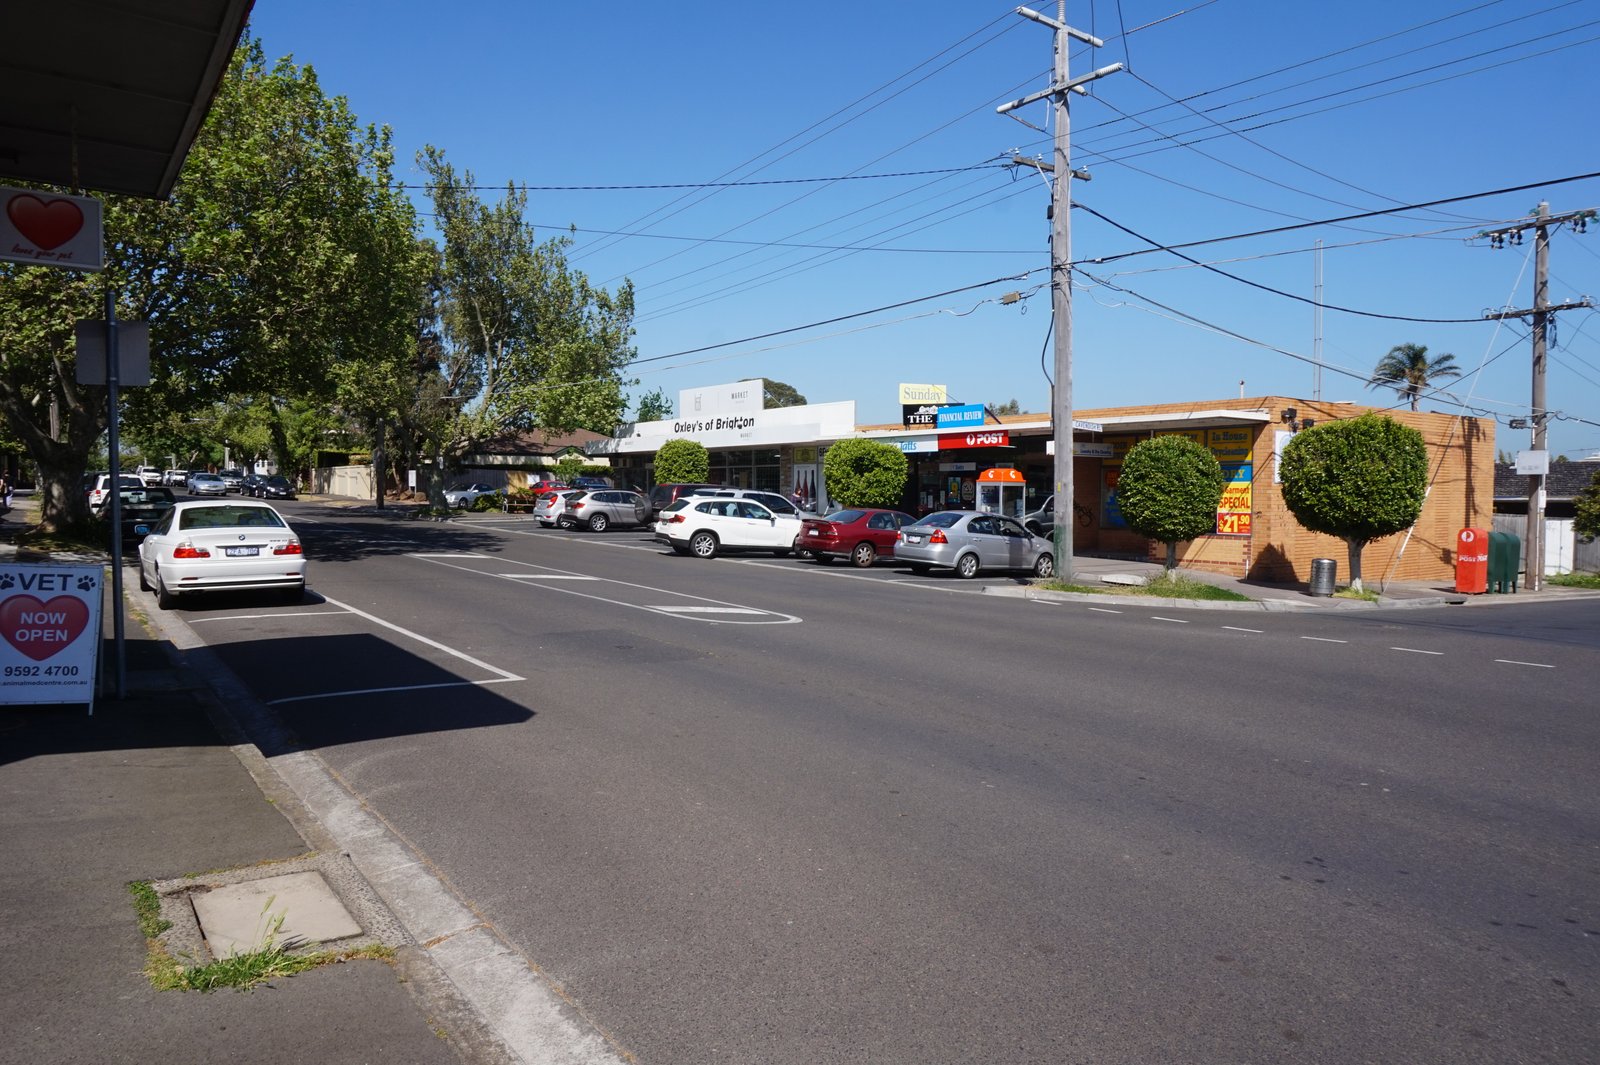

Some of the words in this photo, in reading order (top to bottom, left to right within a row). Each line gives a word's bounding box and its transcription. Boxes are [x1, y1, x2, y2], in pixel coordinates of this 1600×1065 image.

[731, 390, 749, 400] MARKET
[903, 387, 942, 402] Sunday
[907, 414, 933, 424] THE
[939, 412, 963, 422] FINANCIAL
[964, 410, 982, 421] REVIEW
[674, 421, 702, 433] Oxley's
[705, 418, 714, 431] of
[977, 433, 1004, 445] POST
[1222, 431, 1248, 441] House
[900, 441, 917, 451] Tatts
[1219, 496, 1250, 509] SPECIAL
[18, 572, 74, 592] VET
[20, 612, 67, 625] NOW
[15, 629, 68, 642] OPEN
[4, 665, 40, 677] 9592
[44, 665, 79, 677] 4700
